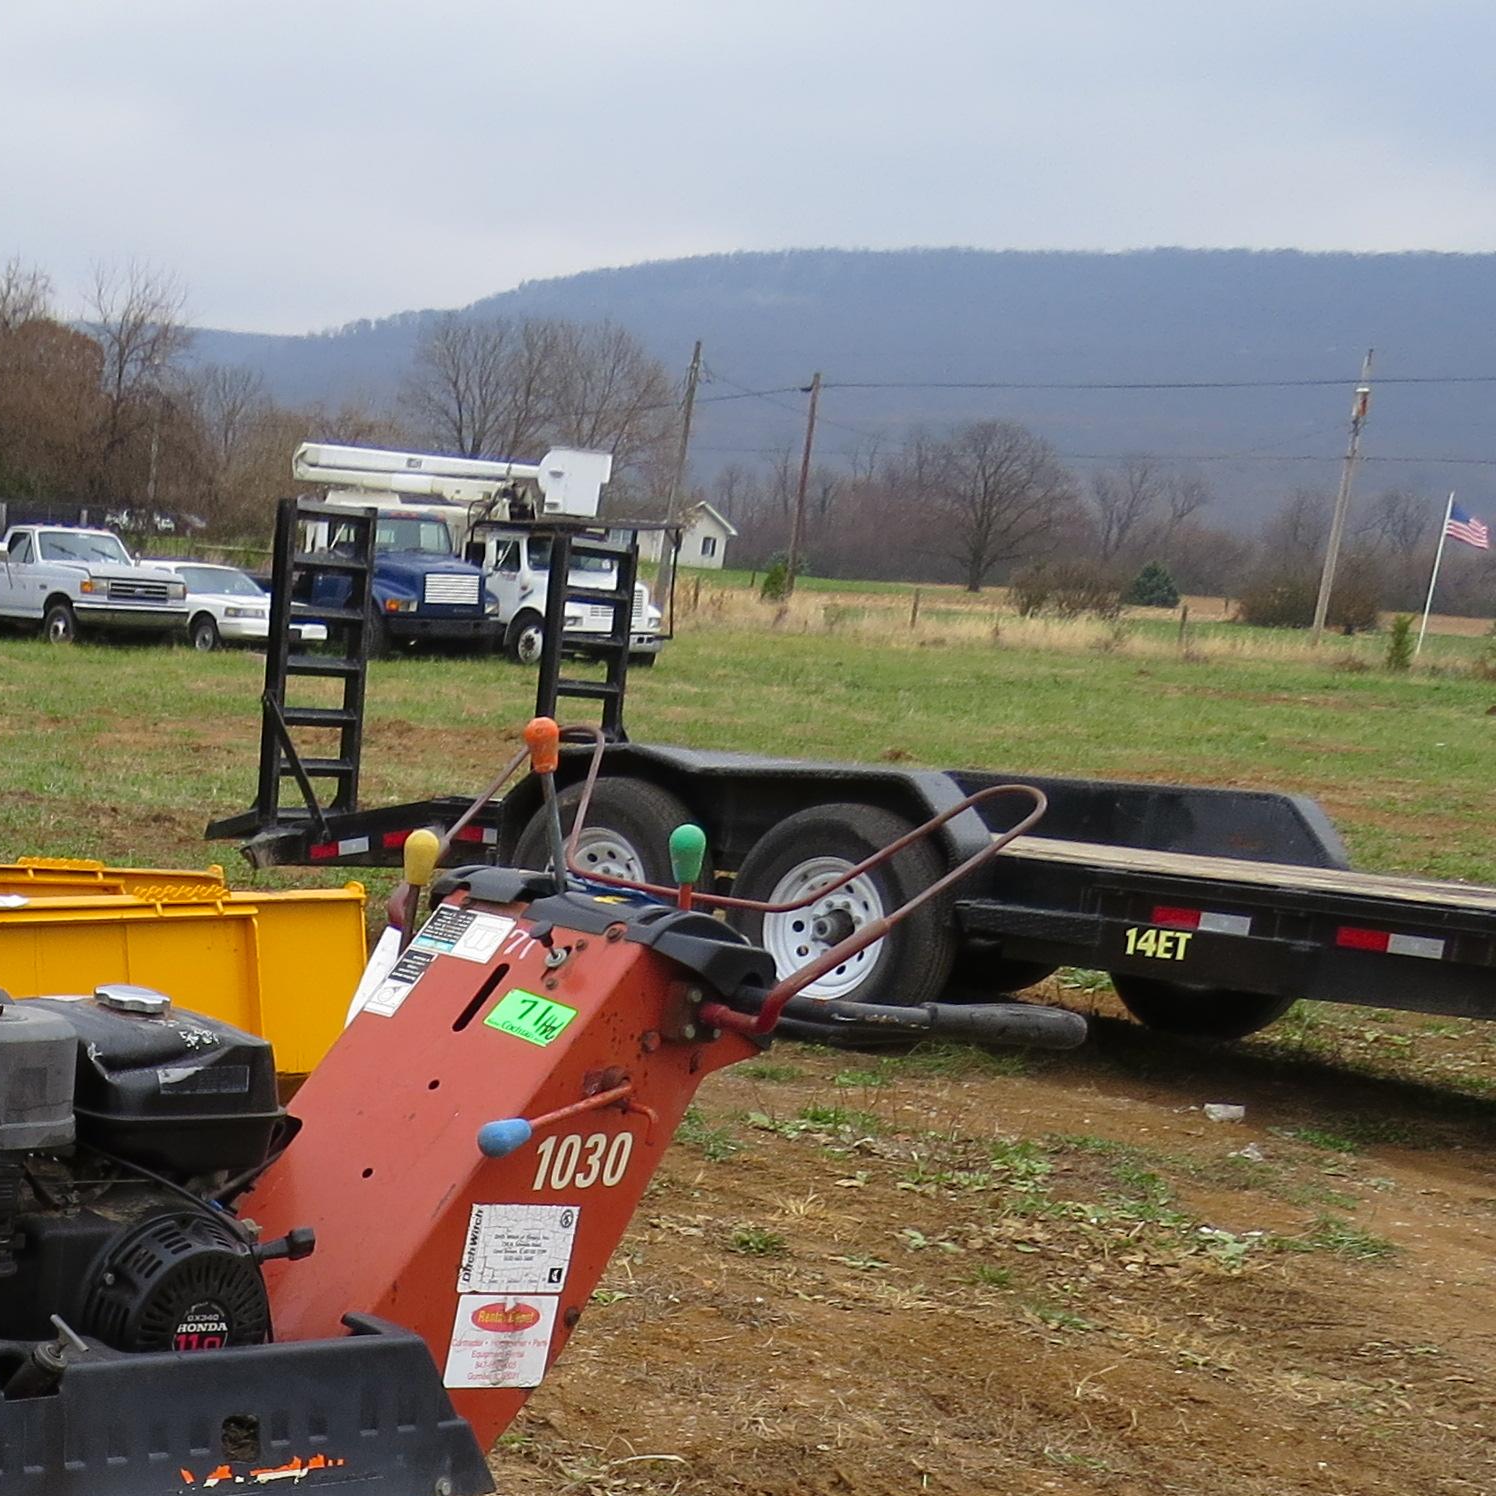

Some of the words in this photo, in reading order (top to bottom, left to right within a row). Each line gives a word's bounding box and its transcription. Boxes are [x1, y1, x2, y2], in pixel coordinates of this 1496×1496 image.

[1124, 927, 1193, 961] 14ET
[532, 1132, 633, 1191] 1030
[177, 1322, 228, 1333] HONDA
